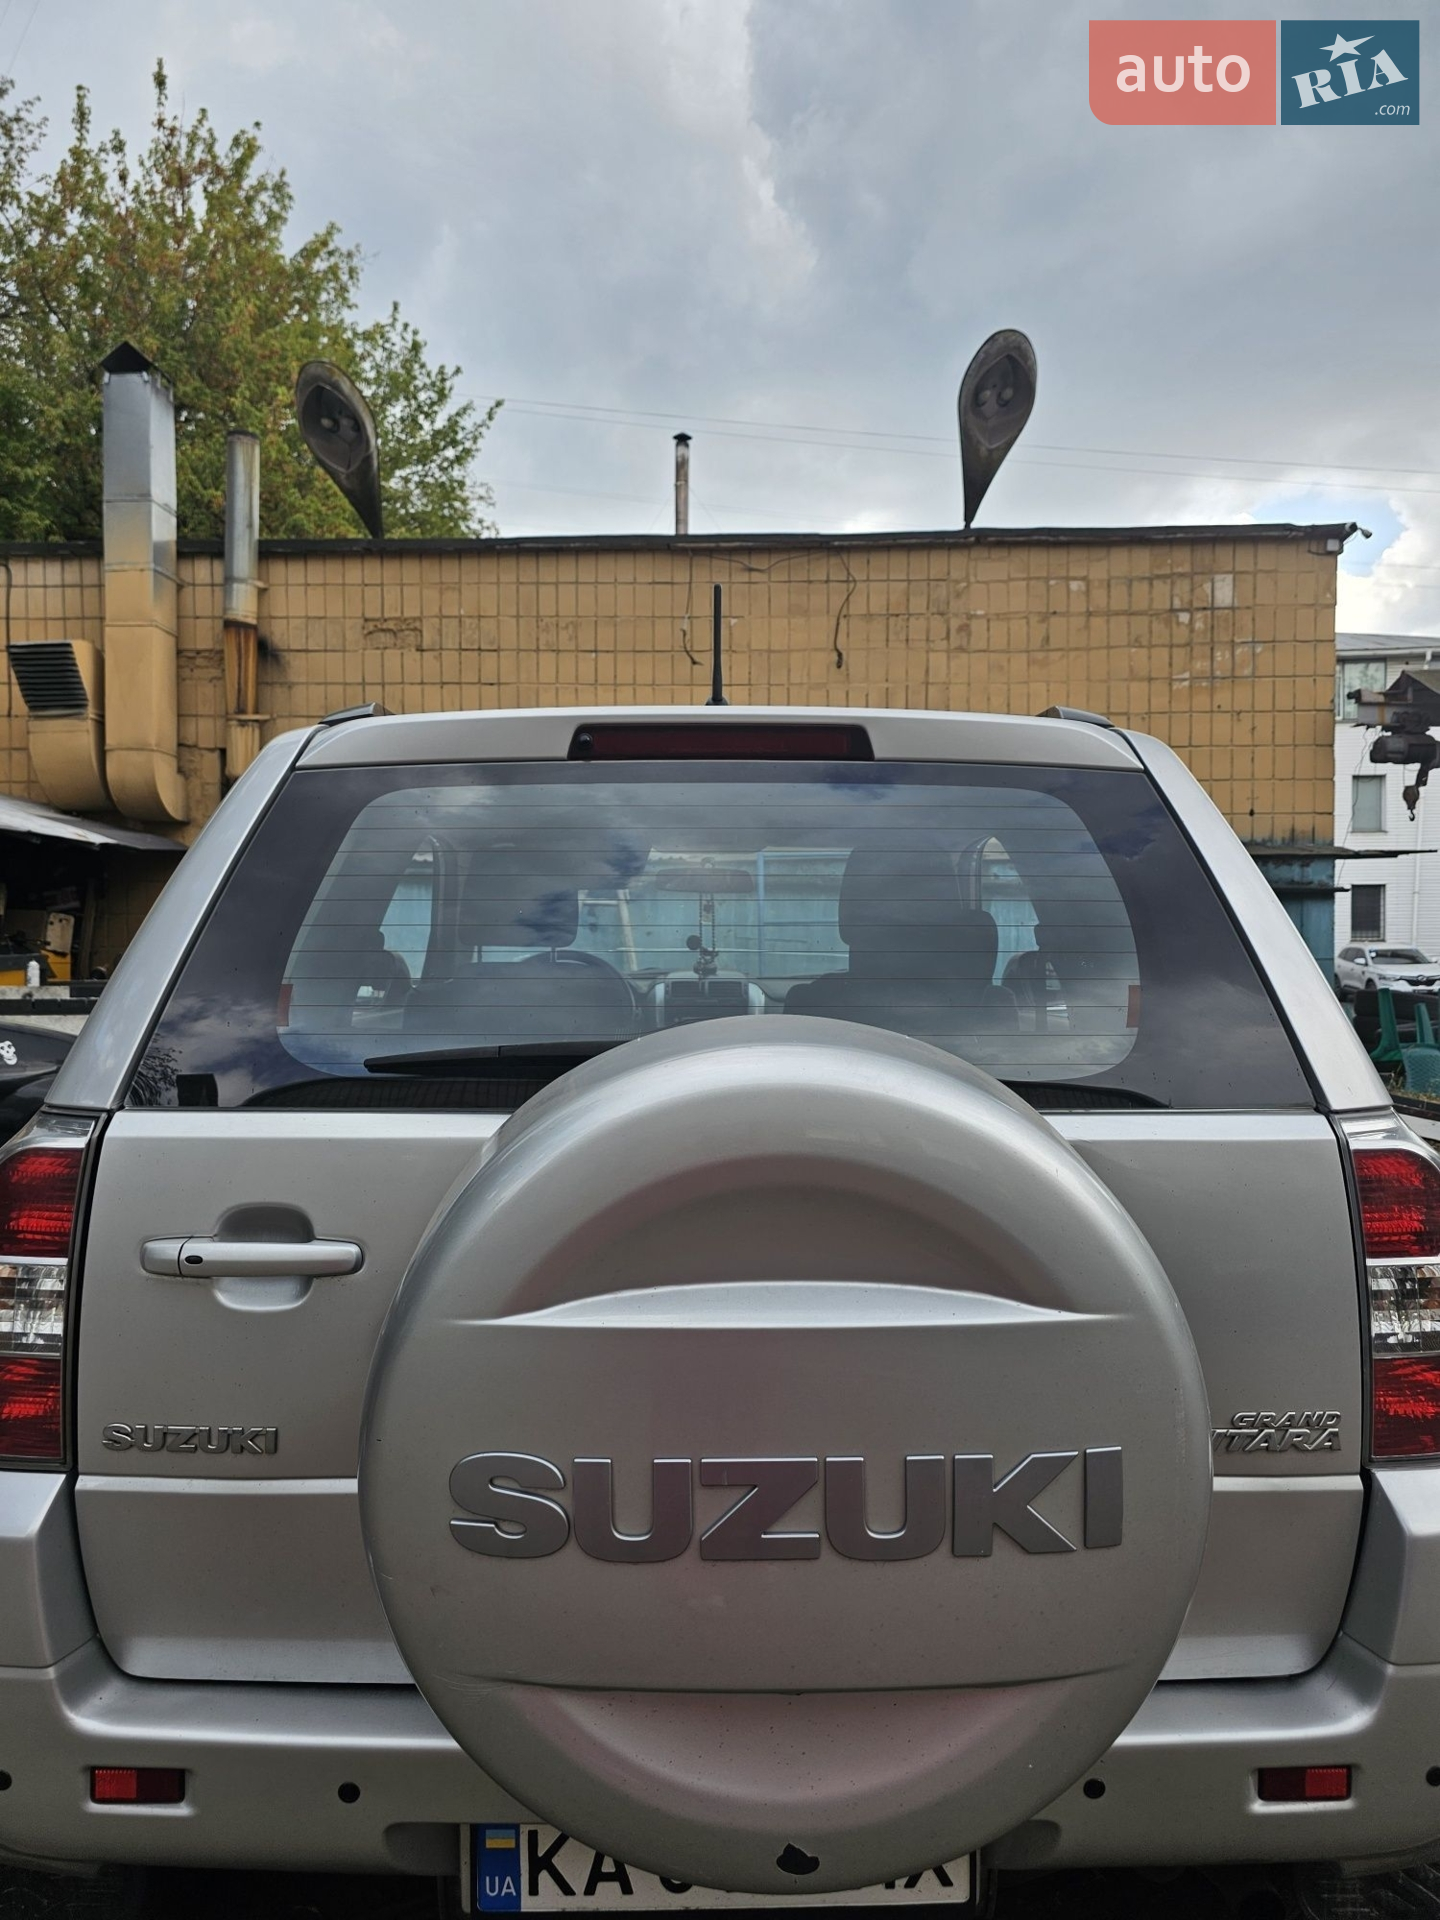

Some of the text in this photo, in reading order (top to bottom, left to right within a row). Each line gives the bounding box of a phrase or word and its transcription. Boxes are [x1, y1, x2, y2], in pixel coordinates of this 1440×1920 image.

[1231, 1410, 1341, 1428] GRAND
[102, 1422, 278, 1454] SUZUKI
[449, 1446, 1123, 1563] SUZUKI
[485, 1876, 516, 1896] UA
